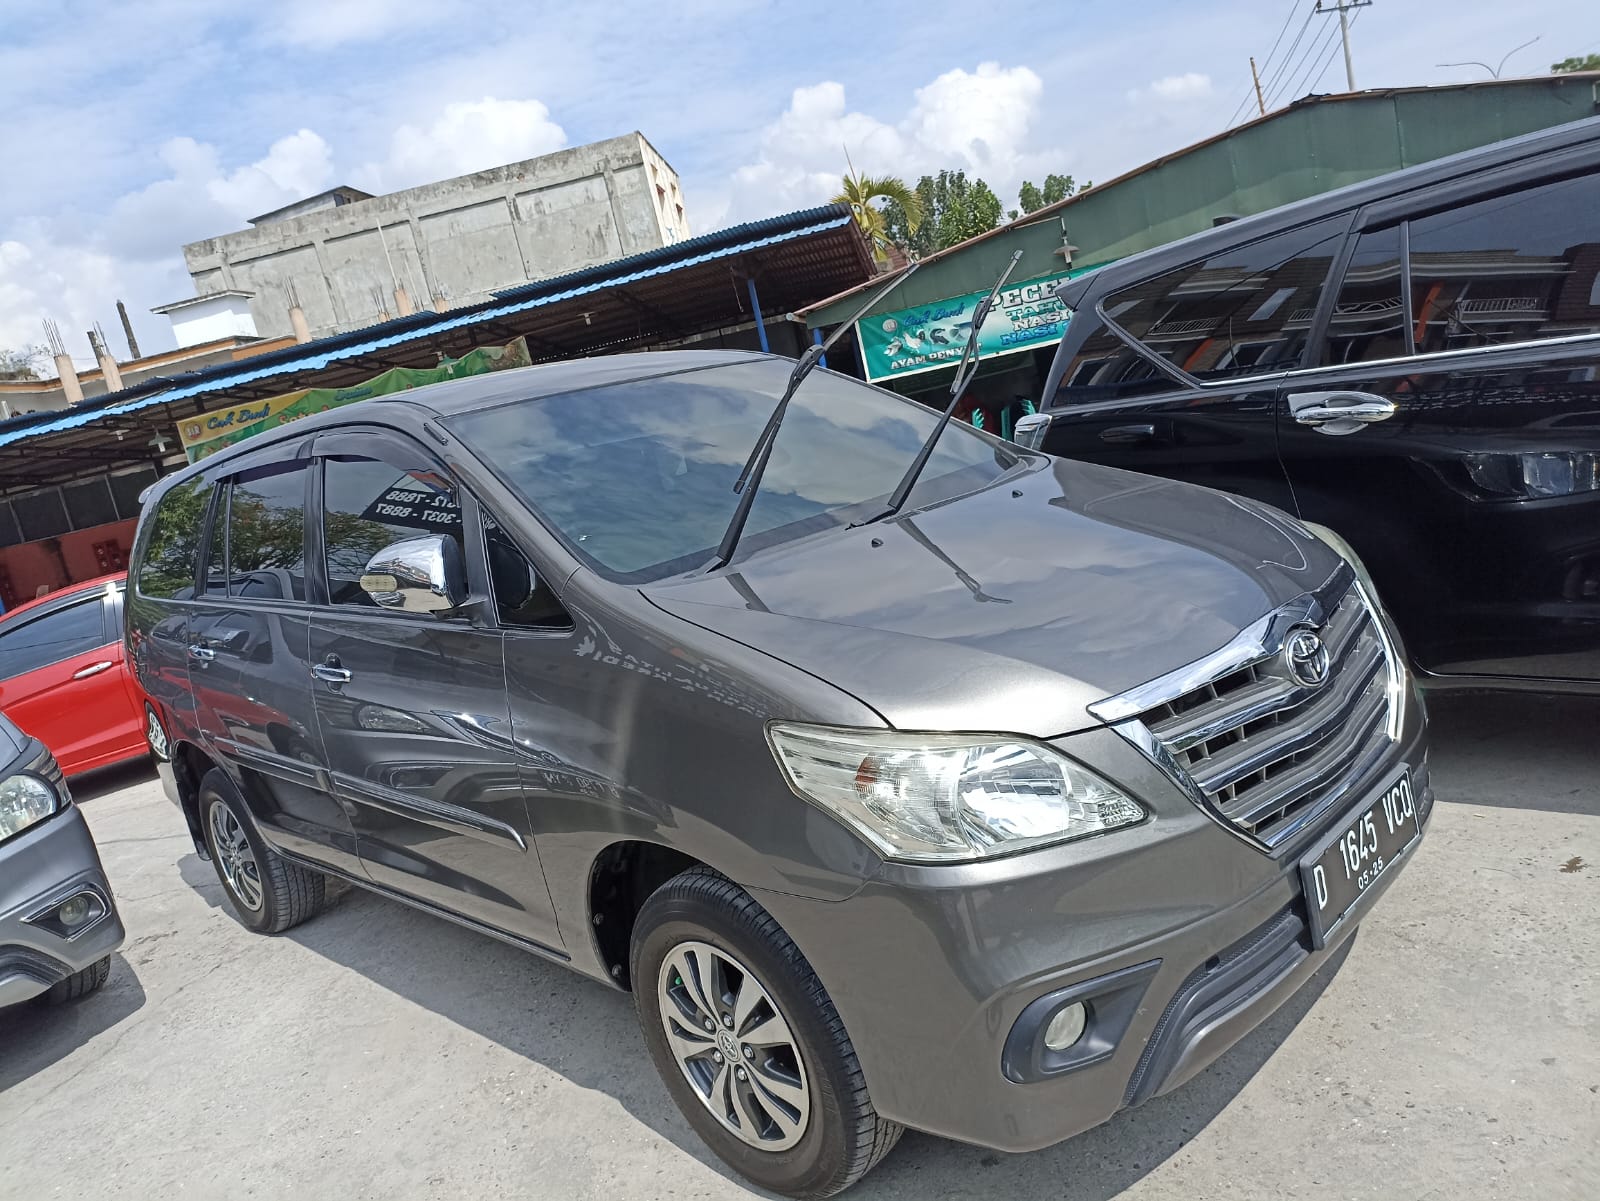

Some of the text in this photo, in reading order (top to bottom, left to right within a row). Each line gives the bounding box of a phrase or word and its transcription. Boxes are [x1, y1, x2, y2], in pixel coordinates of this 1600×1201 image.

[1013, 310, 1070, 332] NASI
[1000, 323, 1058, 346] NASI
[891, 343, 982, 370] AYAM PENY
[1313, 780, 1413, 910] D 1645 VCQ
